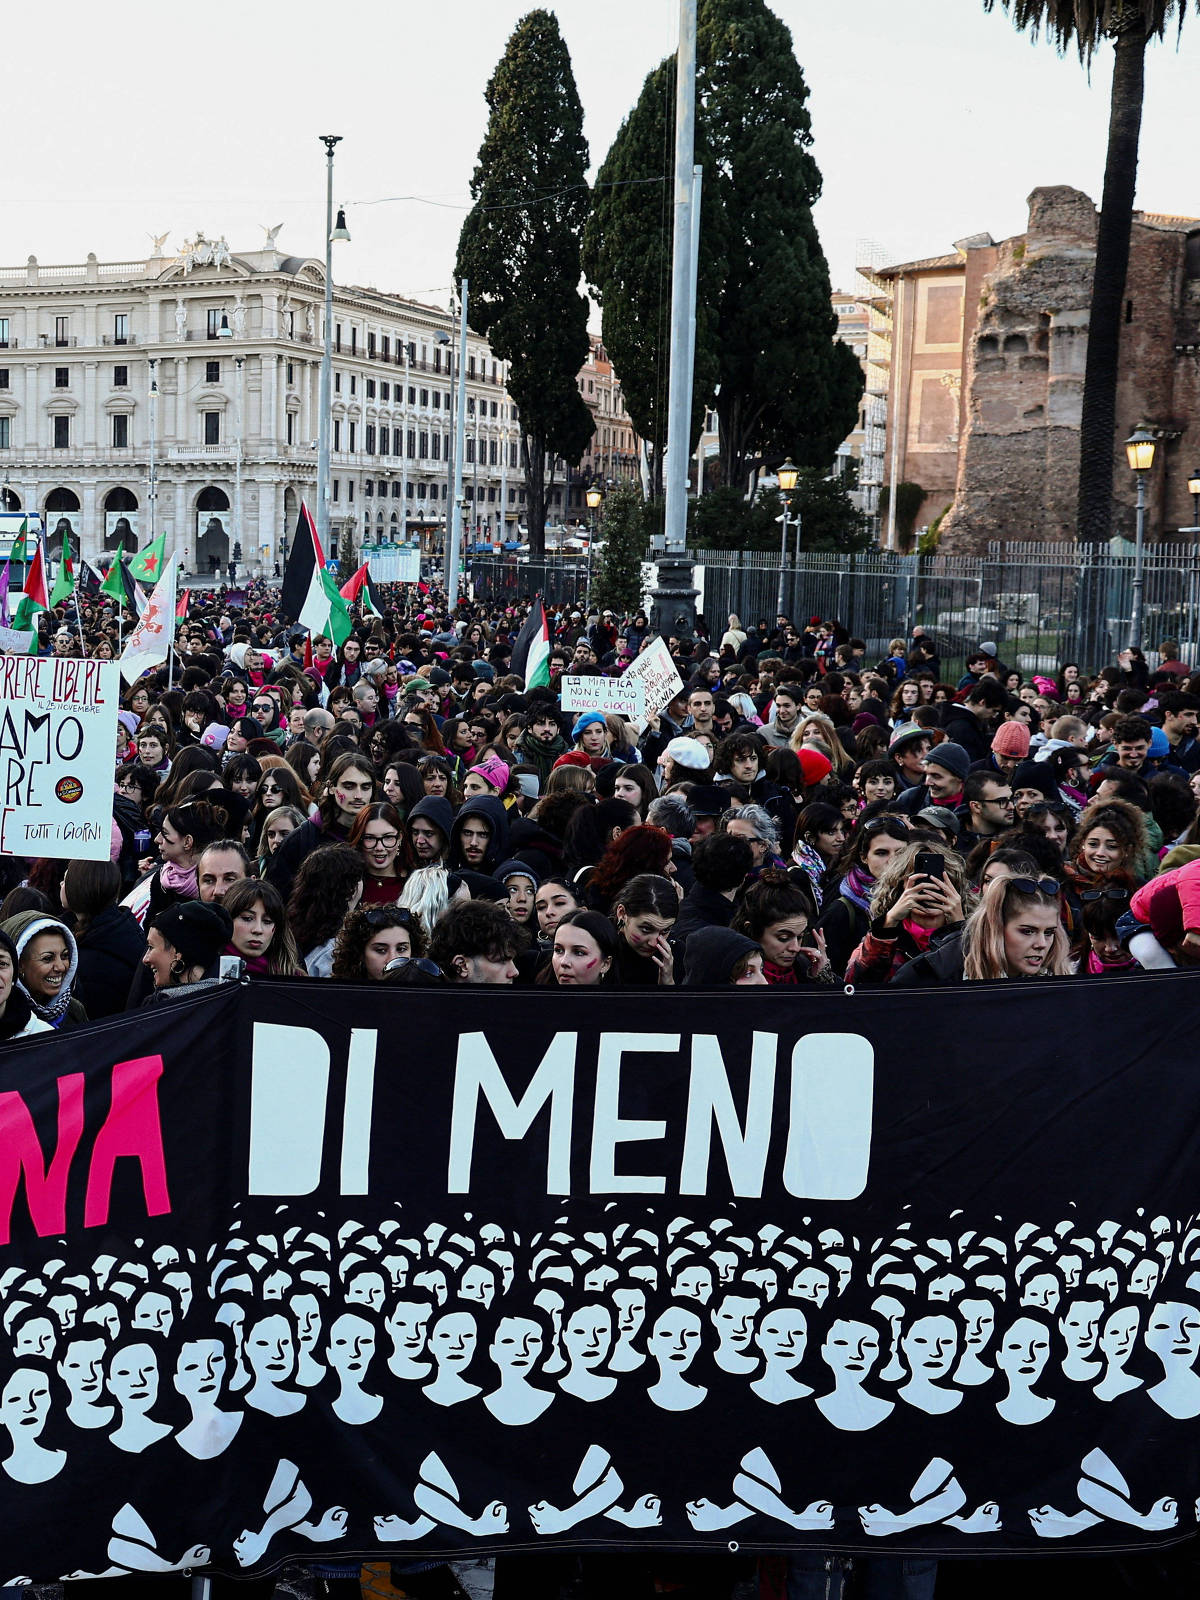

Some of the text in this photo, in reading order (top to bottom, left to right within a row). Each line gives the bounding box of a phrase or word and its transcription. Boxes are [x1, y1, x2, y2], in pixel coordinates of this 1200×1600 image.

[567, 677, 581, 686] LA
[608, 679, 633, 688] FICA
[570, 687, 592, 696] NON
[617, 690, 637, 698] TUO
[38, 700, 100, 715] IL 25 NOVEMBRE
[571, 699, 636, 712] PARCO GIOCHI
[24, 824, 54, 840] TUTTI
[63, 821, 101, 842] GIORNI
[248, 1022, 377, 1196] DI
[448, 1031, 874, 1201] MENO
